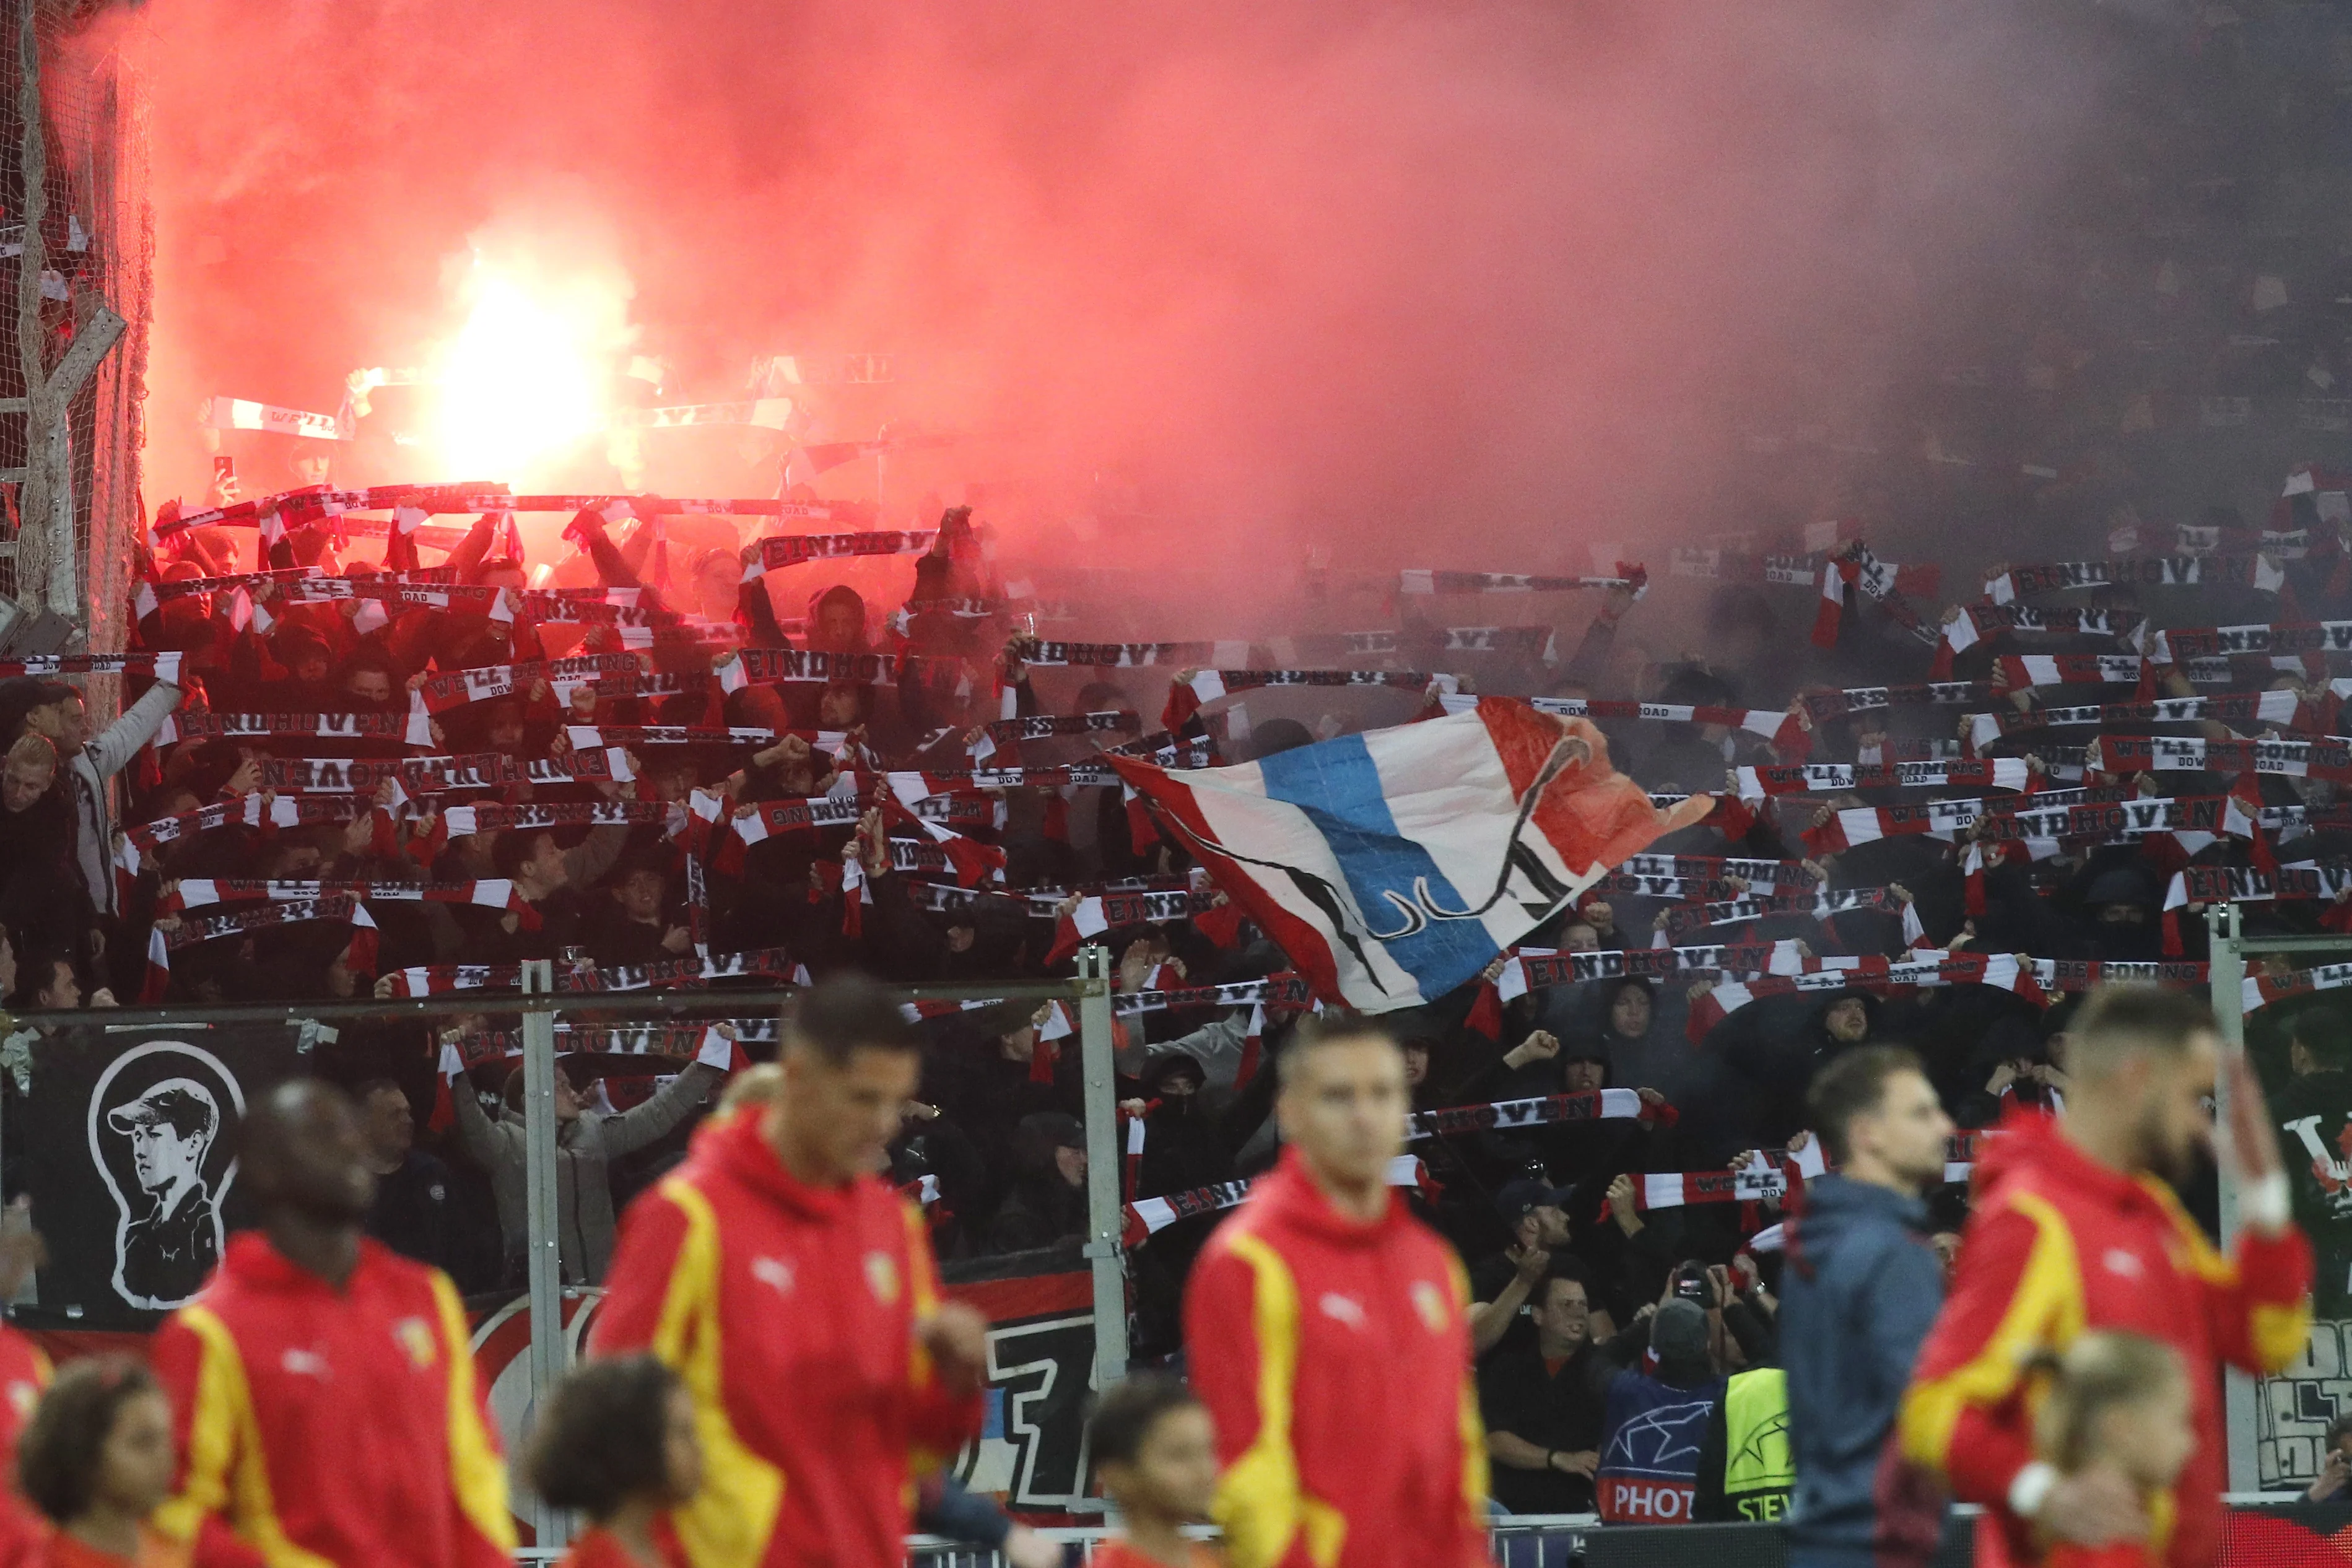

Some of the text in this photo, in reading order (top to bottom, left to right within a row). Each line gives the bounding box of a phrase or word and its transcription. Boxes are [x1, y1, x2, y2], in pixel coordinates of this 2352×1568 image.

[431, 668, 503, 698] WE'LL
[549, 652, 636, 675] COMING
[490, 683, 513, 695] DOW
[180, 713, 404, 736] EINDHOVEN
[2113, 738, 2196, 757] WE'LL
[2249, 741, 2351, 767] COMING
[1767, 766, 1838, 783] WE'LL
[1889, 802, 1972, 823] WELL
[1994, 800, 2219, 840] INDHOVEN
[1528, 947, 1762, 989] EINDHOVEN
[2055, 962, 2197, 981] BE COMING
[1071, 978, 1311, 1021] NDHOVEN
[463, 1028, 700, 1061] EINHOVEN
[1696, 1172, 1778, 1191] WE'LL
